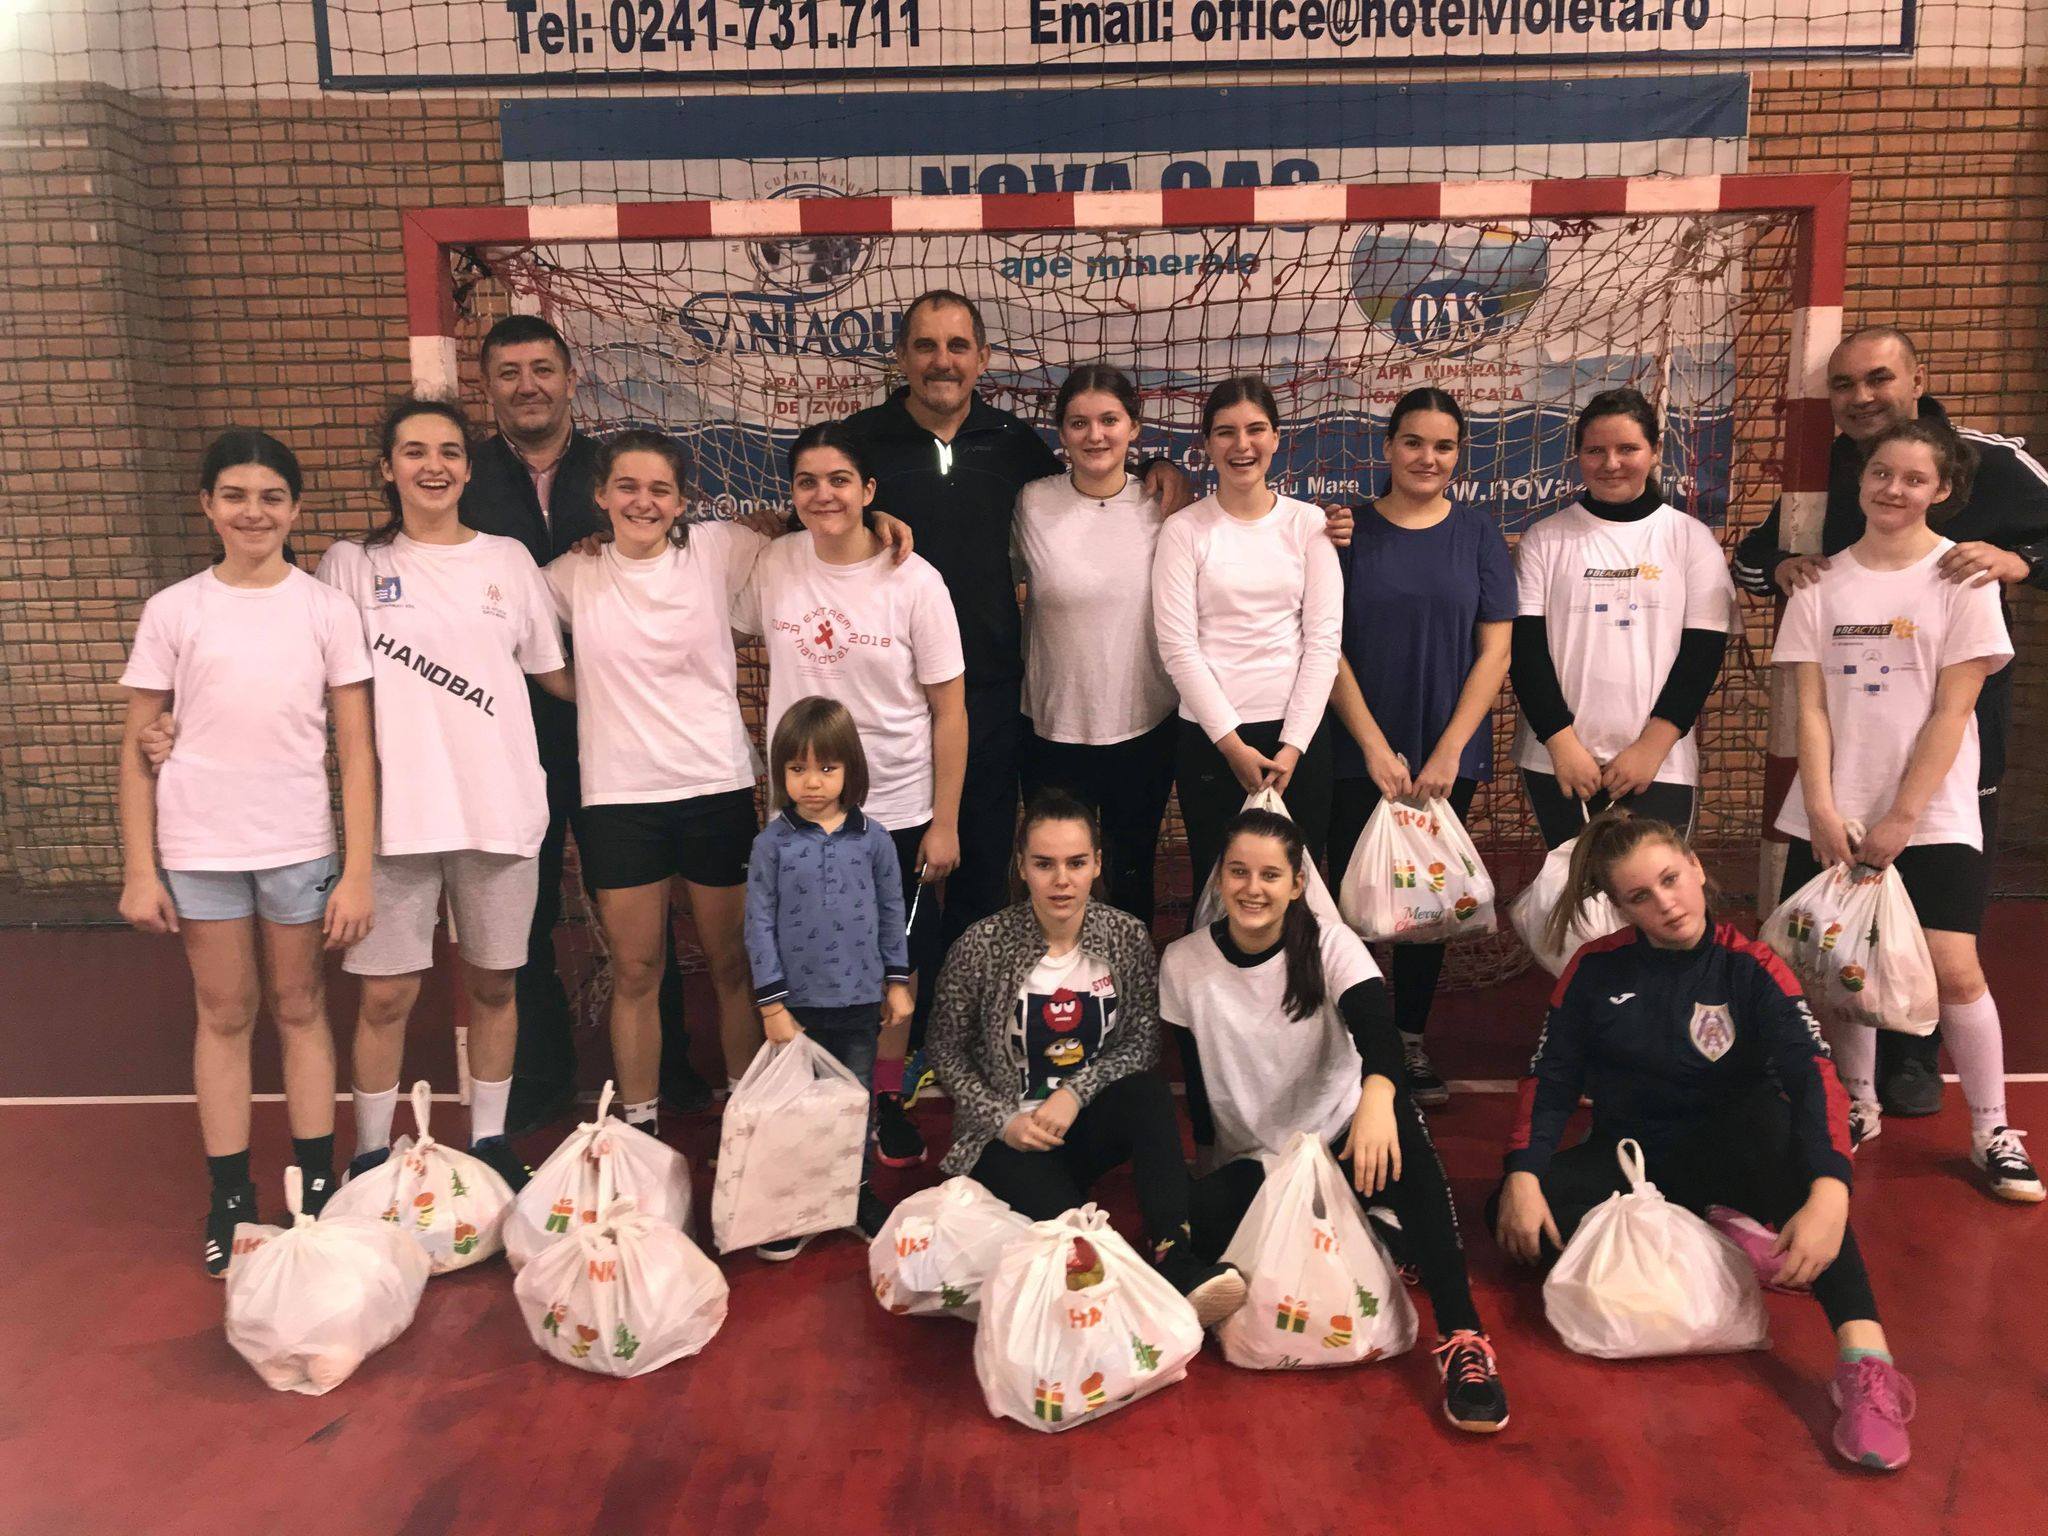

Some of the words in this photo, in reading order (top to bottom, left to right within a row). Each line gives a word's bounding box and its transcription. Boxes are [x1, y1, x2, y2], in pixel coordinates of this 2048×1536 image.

[507, 0, 594, 54] Tel:
[609, 0, 921, 53] 0241-731.711
[1030, 0, 1173, 44] Email:
[1000, 254, 1073, 287] ape
[1087, 247, 1260, 277] minerale
[1307, 476, 1360, 495] Mare
[849, 632, 892, 648] 2018
[373, 633, 496, 717] HANDBAL
